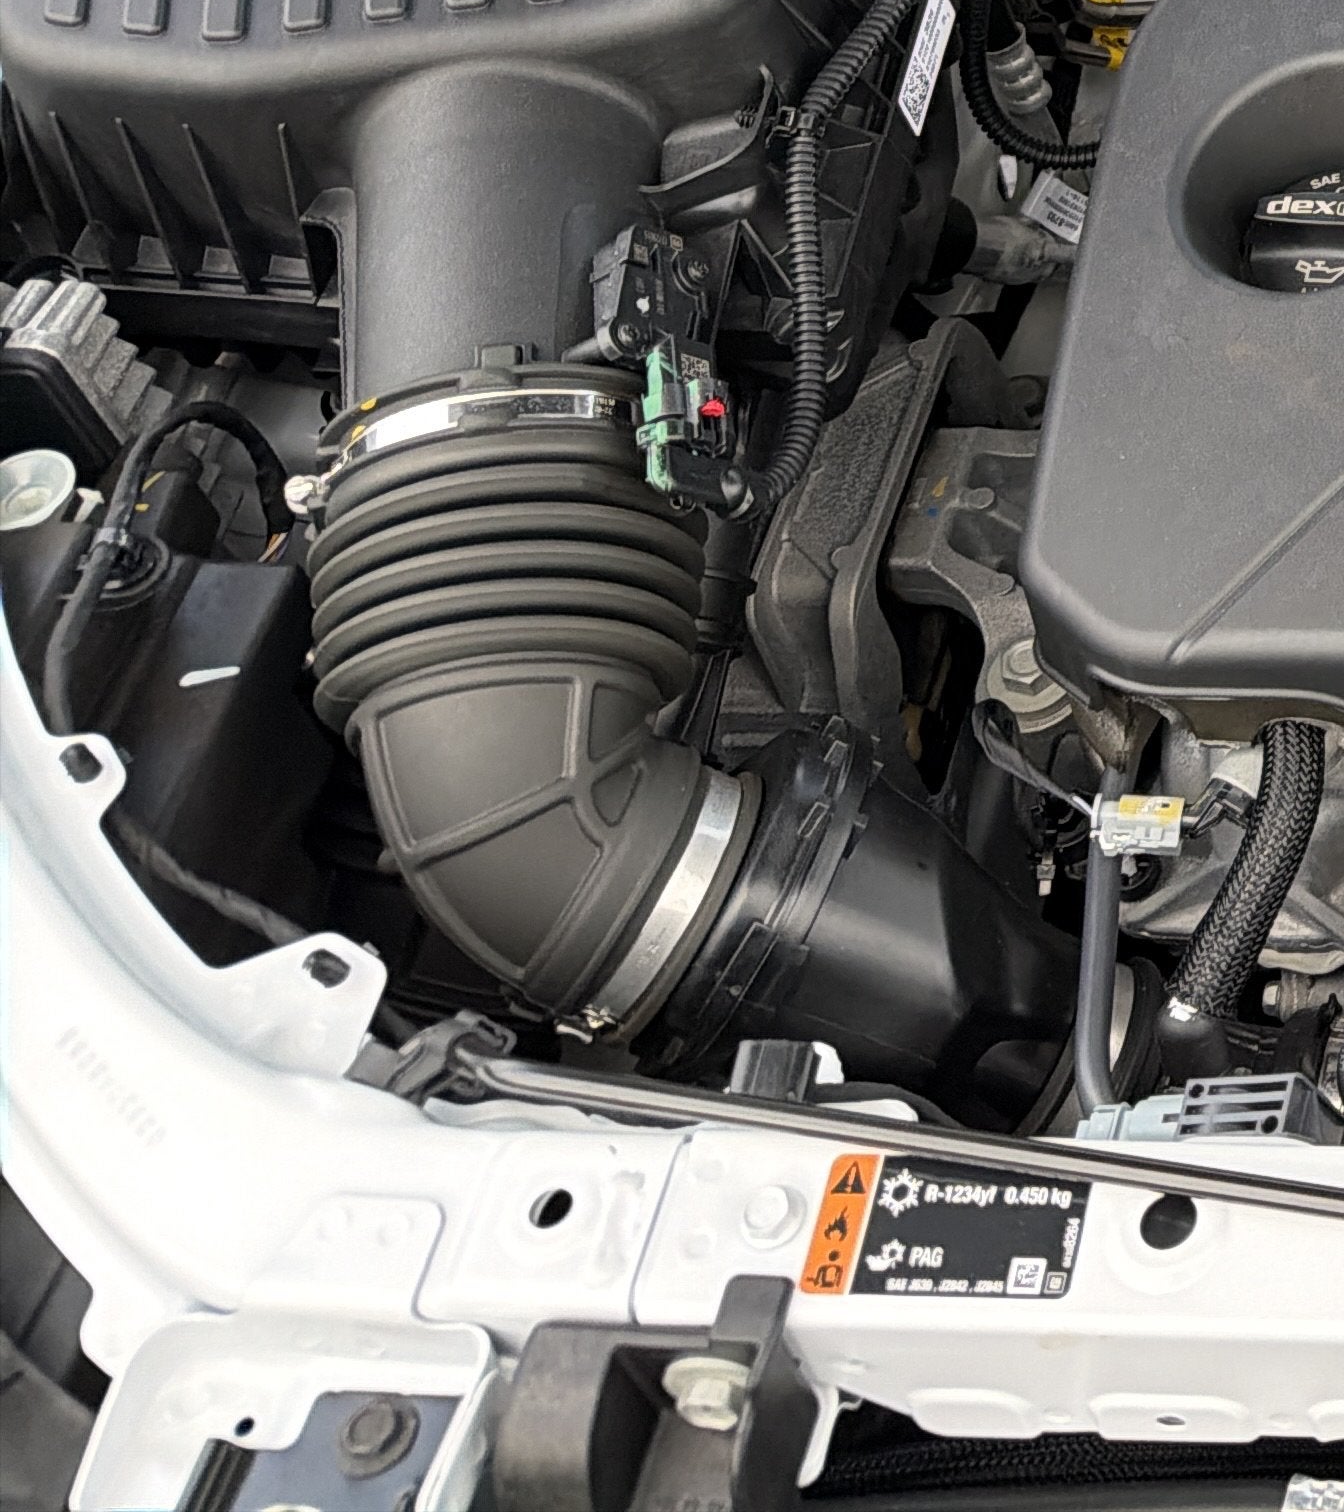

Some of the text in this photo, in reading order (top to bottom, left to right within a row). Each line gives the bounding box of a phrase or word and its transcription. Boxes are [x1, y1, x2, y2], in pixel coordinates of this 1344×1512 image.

[1310, 172, 1341, 190] SAE
[924, 1184, 1072, 1209] R-1234yf 0.450 kg
[909, 1246, 945, 1268] PAG
